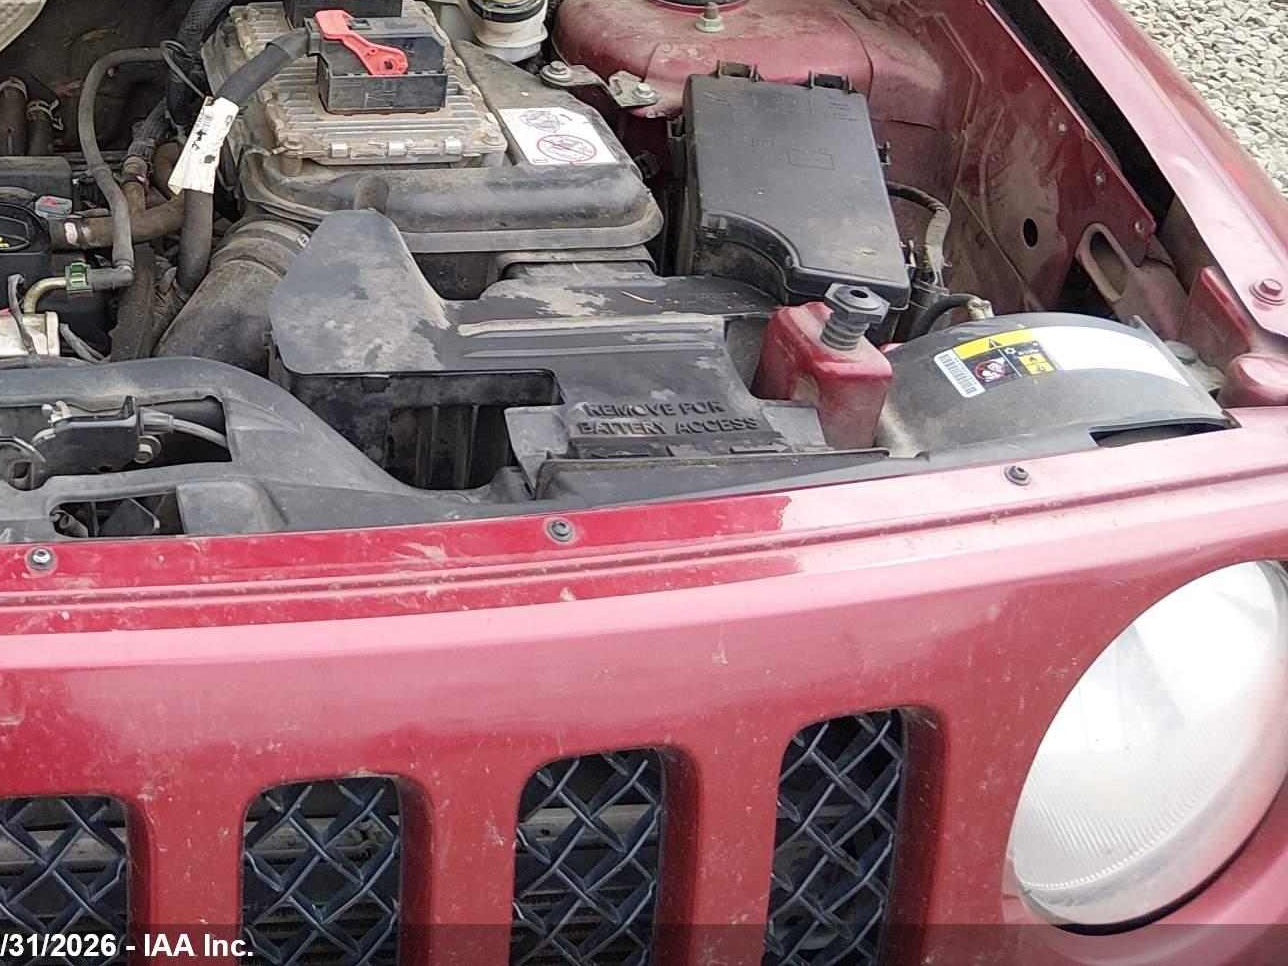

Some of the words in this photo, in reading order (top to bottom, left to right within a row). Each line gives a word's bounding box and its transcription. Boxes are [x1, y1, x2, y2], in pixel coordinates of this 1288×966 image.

[584, 402, 676, 417] REMOVE
[678, 401, 726, 415] FOR
[577, 421, 667, 435] BATTERY
[675, 417, 760, 435] ACCESS
